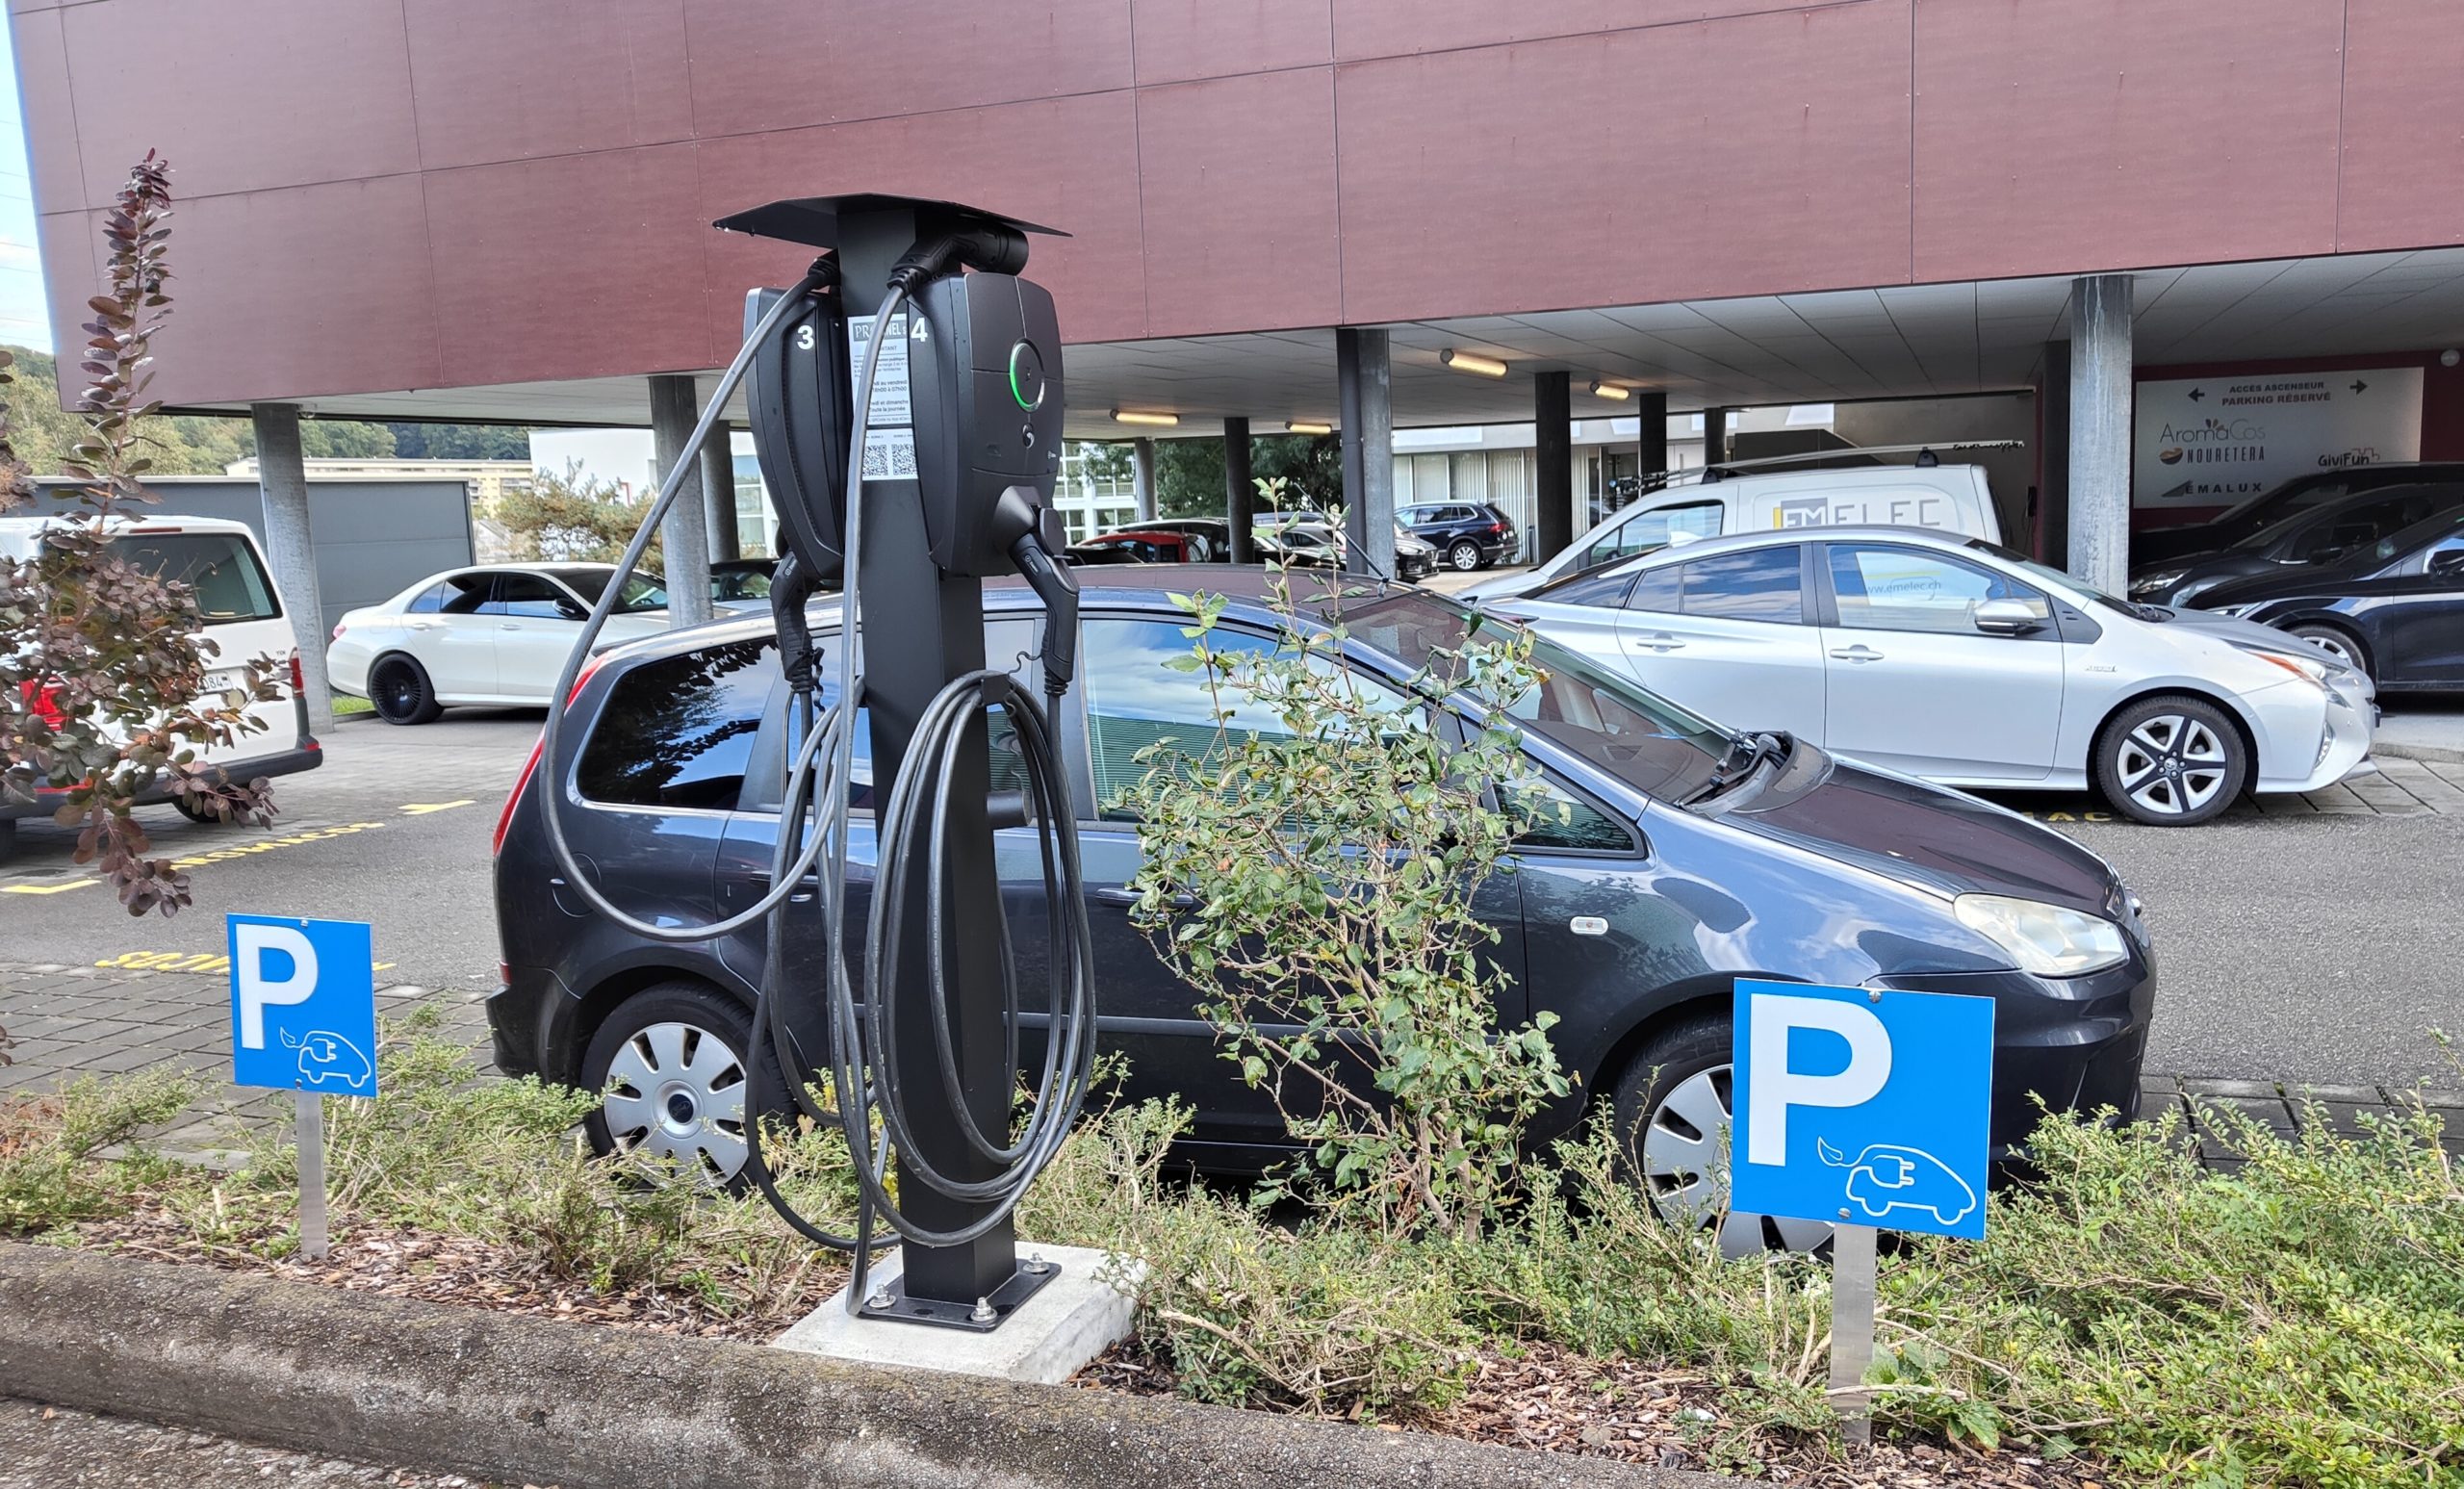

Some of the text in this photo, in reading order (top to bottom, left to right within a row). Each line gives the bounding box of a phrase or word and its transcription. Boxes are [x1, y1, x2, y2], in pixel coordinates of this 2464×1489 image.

[797, 325, 814, 350] 3
[911, 317, 928, 342] 4
[2221, 395, 2273, 407] PARKING
[2159, 419, 2266, 444] AromaCos
[2187, 446, 2265, 463] NOURETERA
[236, 923, 319, 1050] P
[1748, 992, 1892, 1167] P
